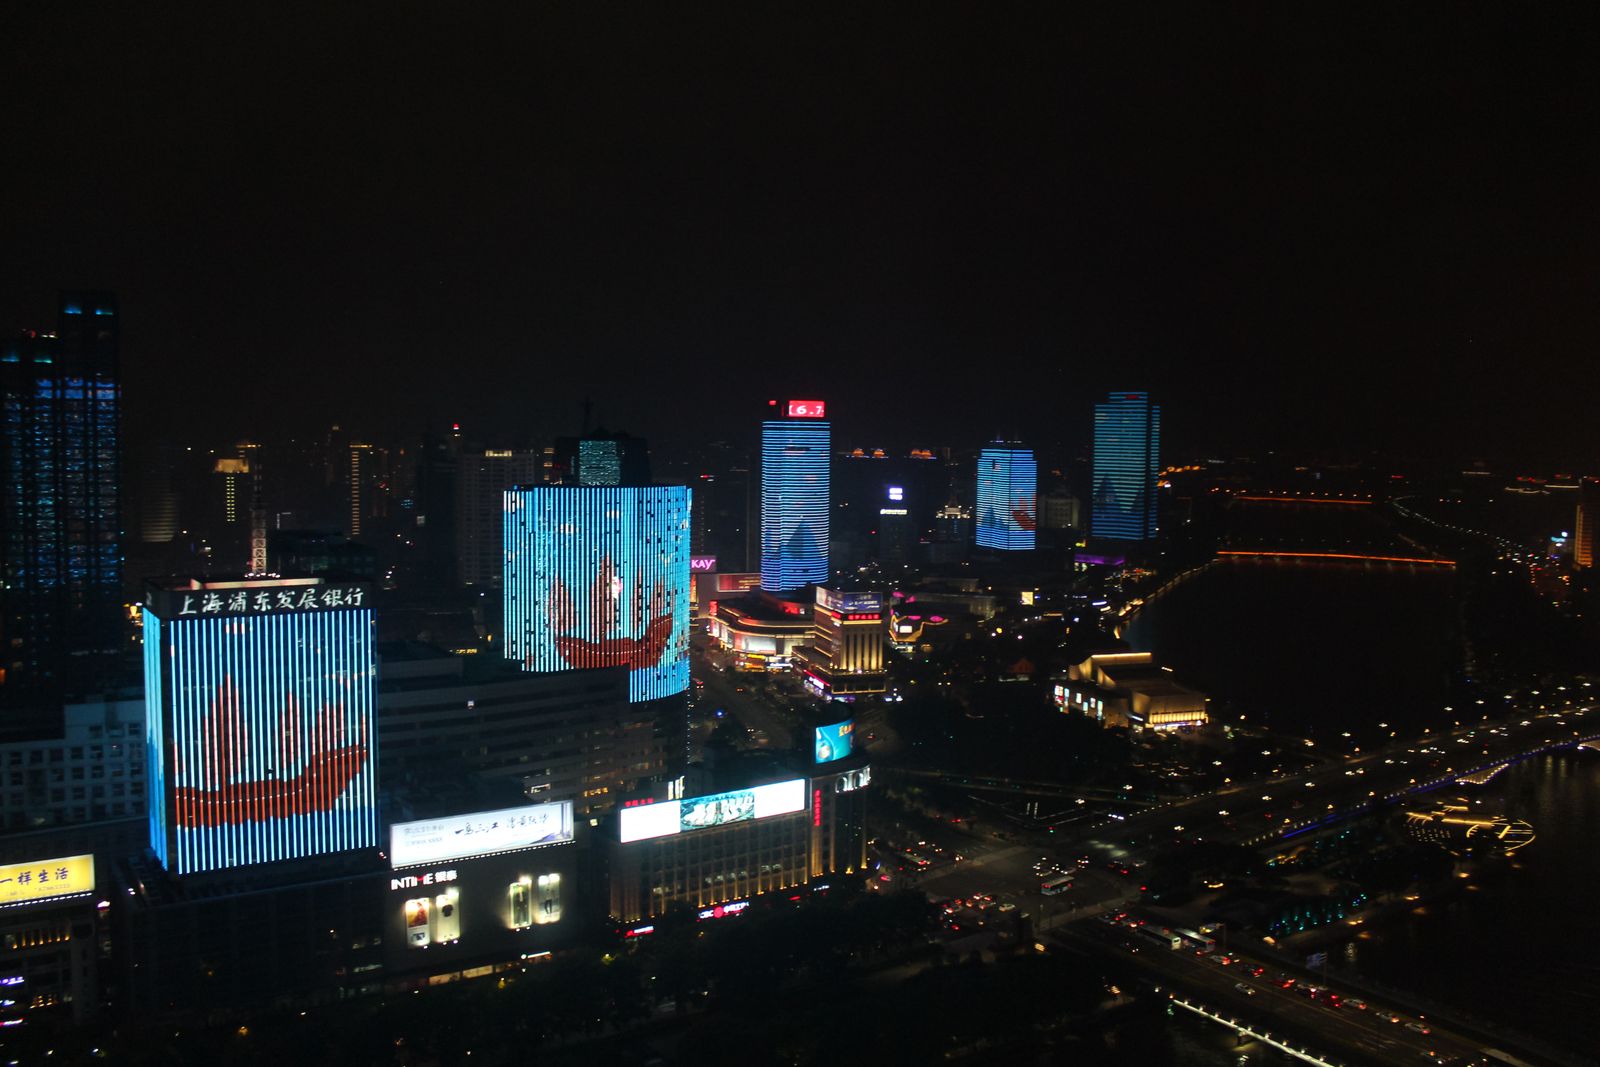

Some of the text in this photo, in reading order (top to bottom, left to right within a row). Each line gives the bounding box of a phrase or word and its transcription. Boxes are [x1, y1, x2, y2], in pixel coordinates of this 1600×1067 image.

[178, 587, 364, 616] 上海浦东发展银行
